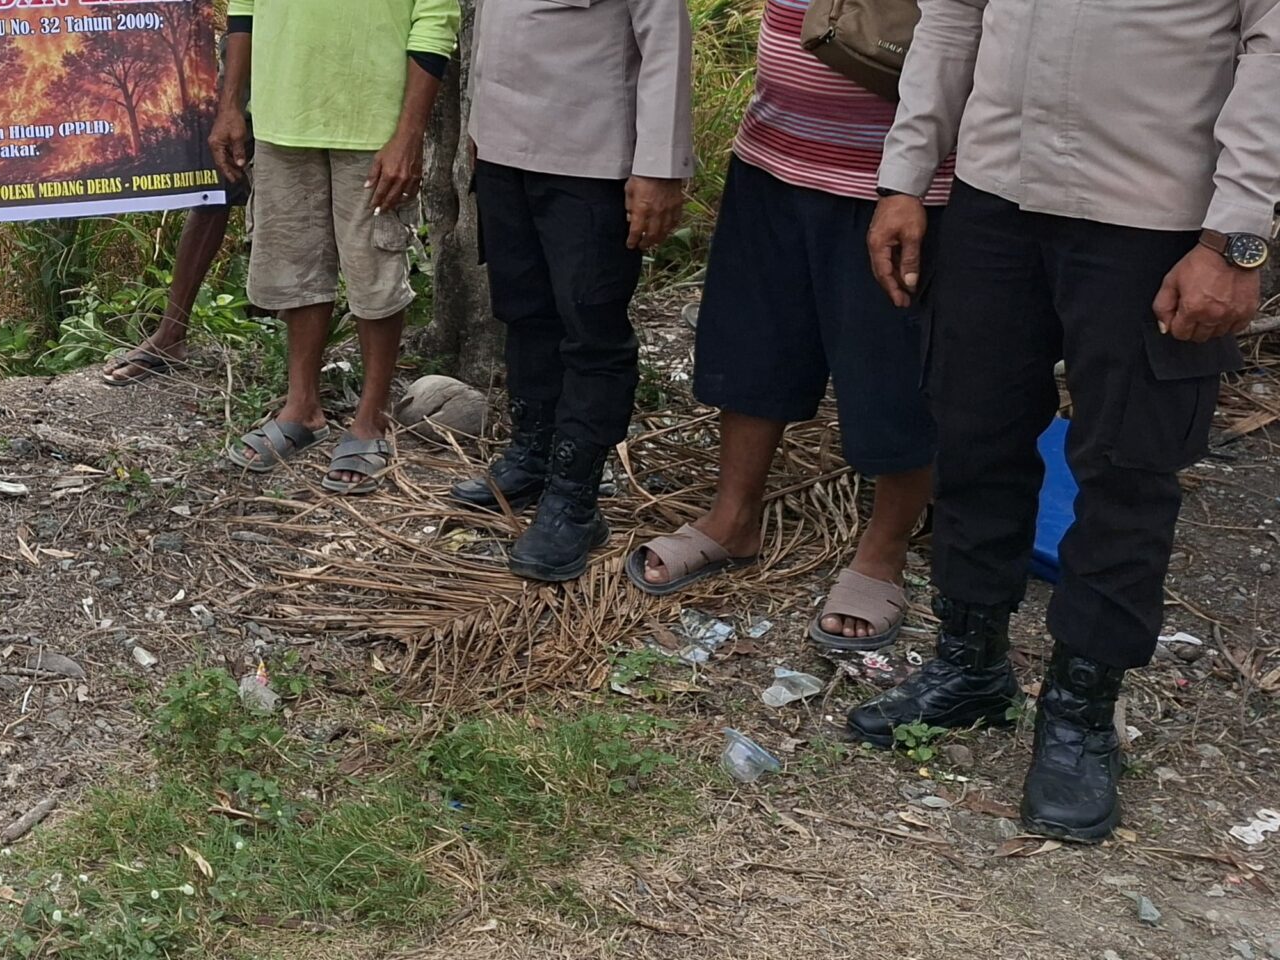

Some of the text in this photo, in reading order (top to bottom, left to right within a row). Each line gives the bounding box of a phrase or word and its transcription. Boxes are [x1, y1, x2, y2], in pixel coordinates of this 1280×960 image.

[11, 18, 35, 36] No.
[41, 17, 60, 33] 32
[65, 16, 112, 32] Tahun
[117, 12, 164, 30] 2009):
[9, 123, 54, 140] Hidup
[59, 120, 114, 138] (PPLH):
[38, 180, 83, 198] MEDANG
[87, 178, 122, 194] DERAS
[132, 174, 171, 191] POLRES
[174, 171, 194, 187] BATU
